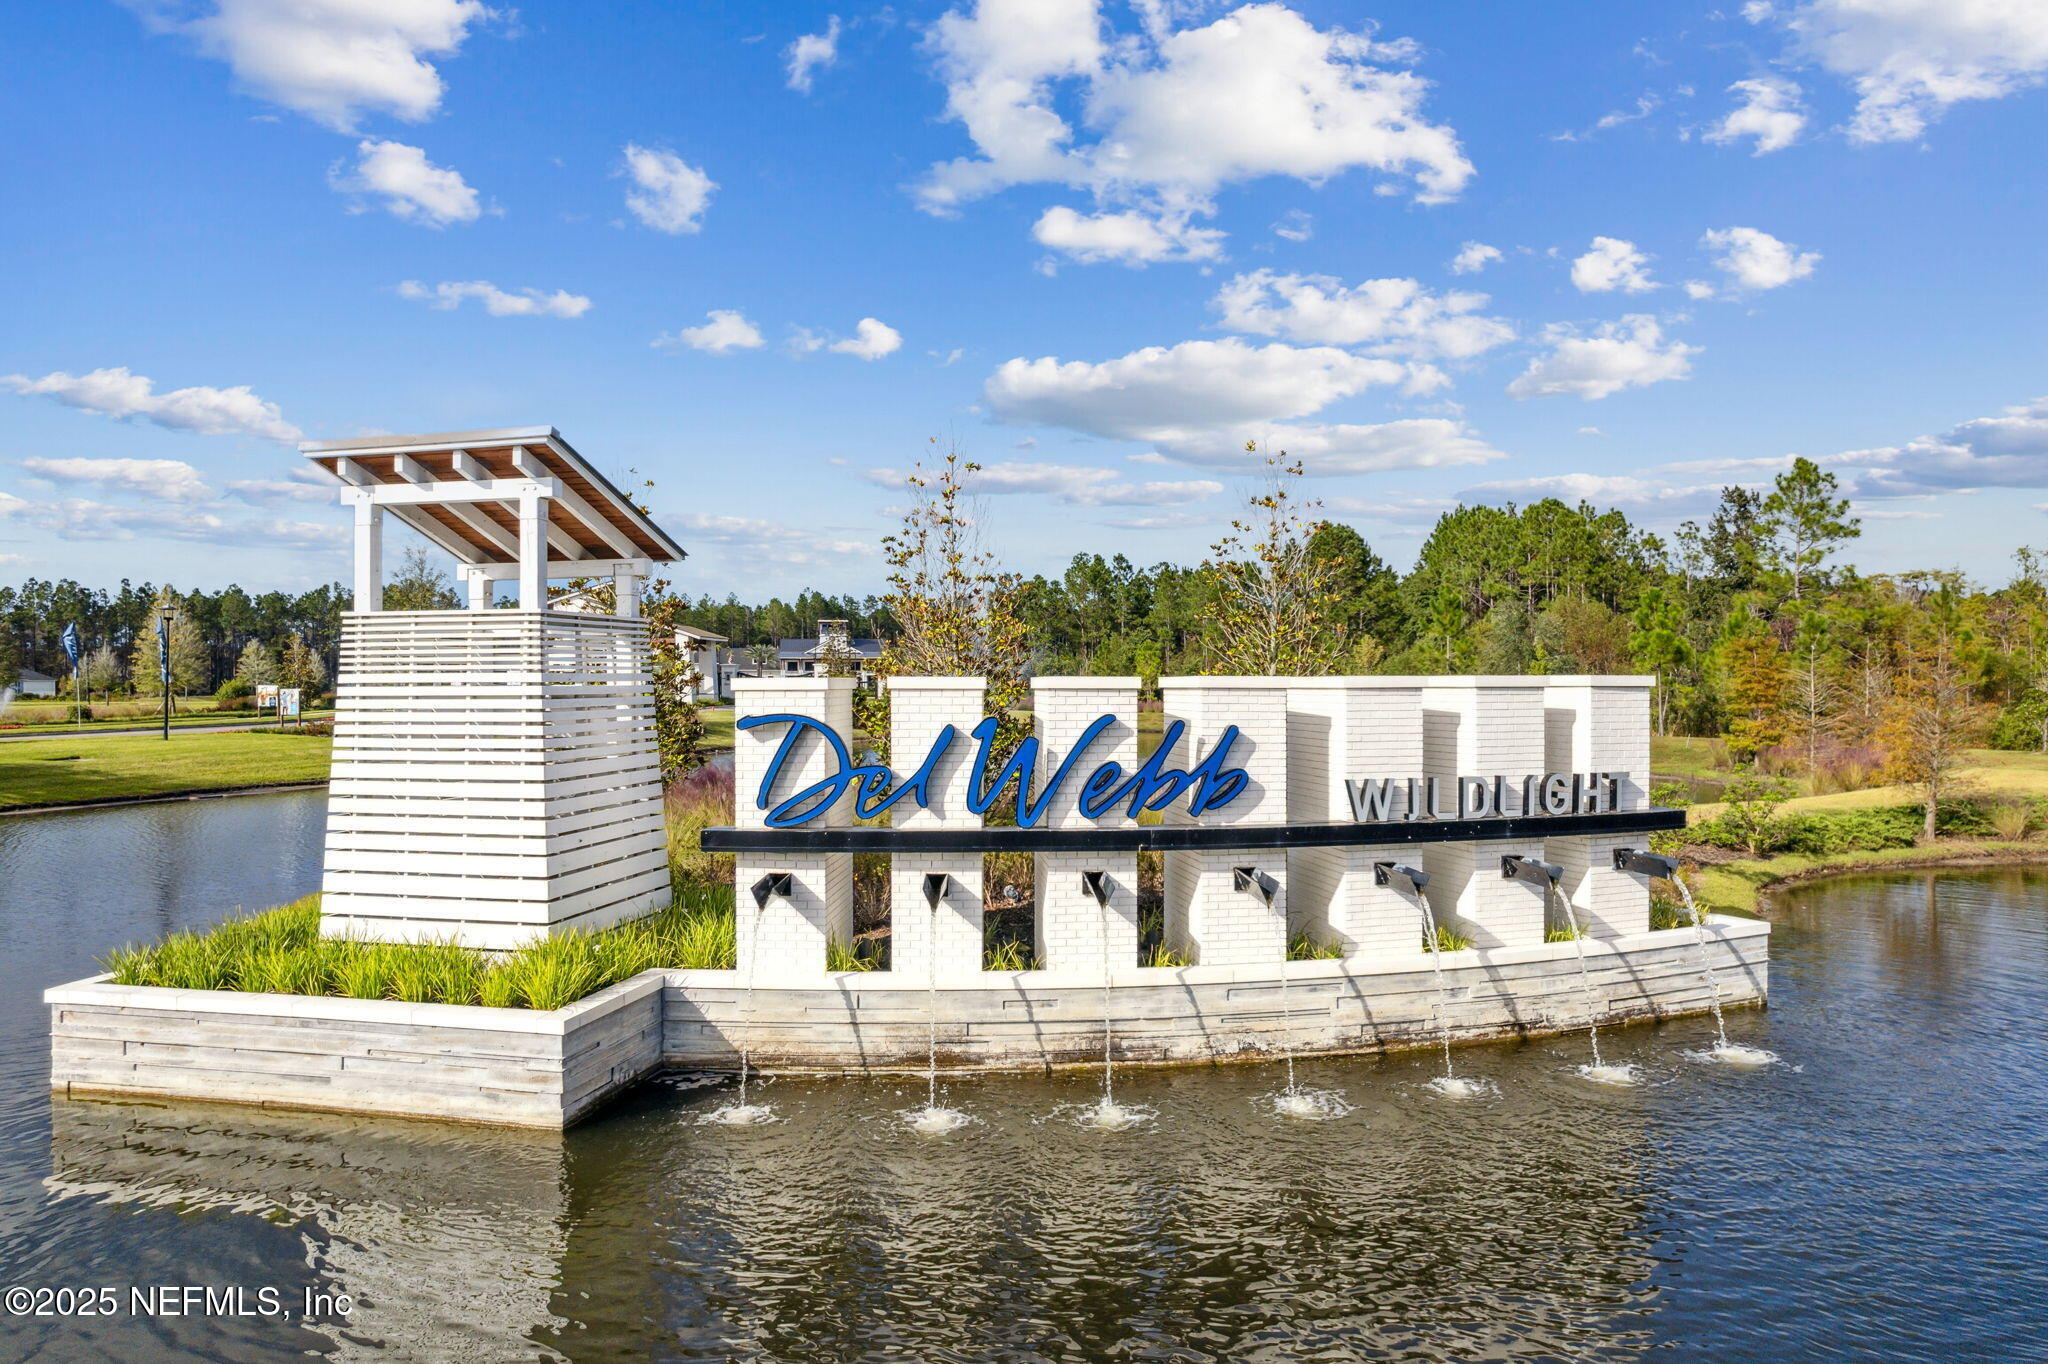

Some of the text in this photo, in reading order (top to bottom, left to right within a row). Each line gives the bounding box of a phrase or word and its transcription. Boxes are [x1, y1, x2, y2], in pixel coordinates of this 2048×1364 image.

[736, 713, 1250, 829] Del Webb
[1344, 771, 1630, 823] WILDLIGHT
